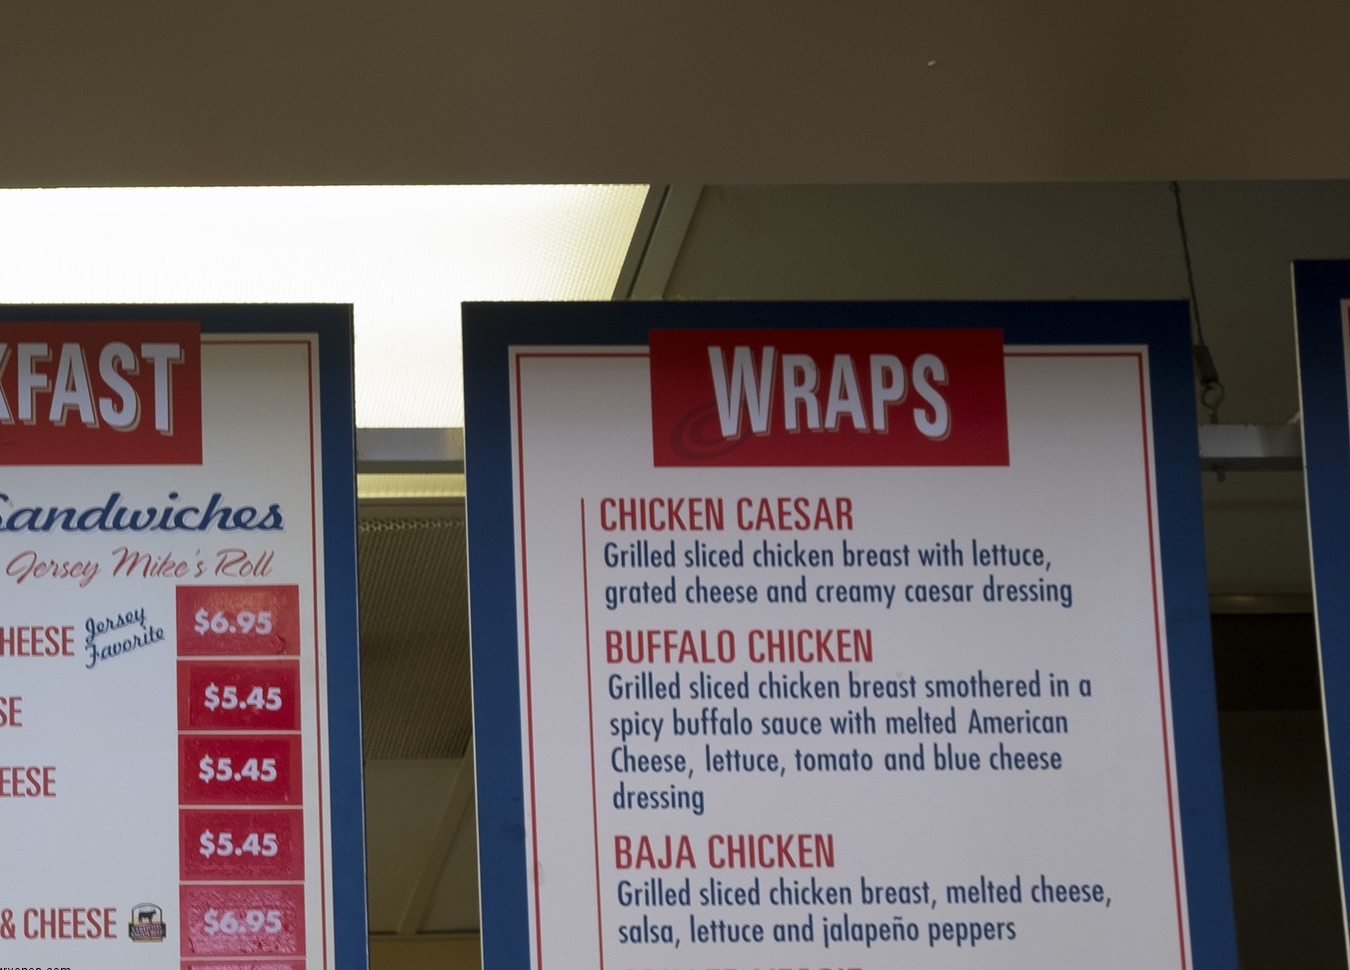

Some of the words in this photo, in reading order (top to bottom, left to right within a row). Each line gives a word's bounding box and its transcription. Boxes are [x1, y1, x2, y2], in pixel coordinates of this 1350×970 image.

[708, 346, 950, 441] WRAPS
[600, 497, 725, 532] CHICKEN
[736, 497, 853, 531] CAESAR
[4, 551, 101, 590] Jersey
[112, 547, 208, 583] Mike's
[213, 547, 276, 580] Roll
[603, 539, 676, 568] Grilled
[684, 539, 744, 568] sliced
[752, 539, 834, 568] chicken
[842, 539, 910, 567] breast
[917, 538, 964, 567] with
[971, 538, 1051, 572] lettuce,
[605, 575, 677, 611] grated
[685, 575, 758, 604] cheese
[766, 574, 807, 604] and
[815, 584, 896, 609] creamy
[904, 584, 974, 603] caesar
[982, 574, 1073, 609] dressing
[85, 607, 146, 645] Jersey
[193, 607, 273, 636] $6.95
[85, 626, 165, 669] Favorite
[605, 629, 736, 664] BUFFALO
[748, 628, 873, 664] CHICKEN
[204, 682, 283, 712] $5.45
[612, 781, 705, 816] dressing
[614, 834, 697, 870] BAJA
[708, 833, 835, 869] CHICKEN
[0, 908, 16, 940] &
[23, 907, 118, 940] CHEESE
[203, 908, 283, 939] $6.95
